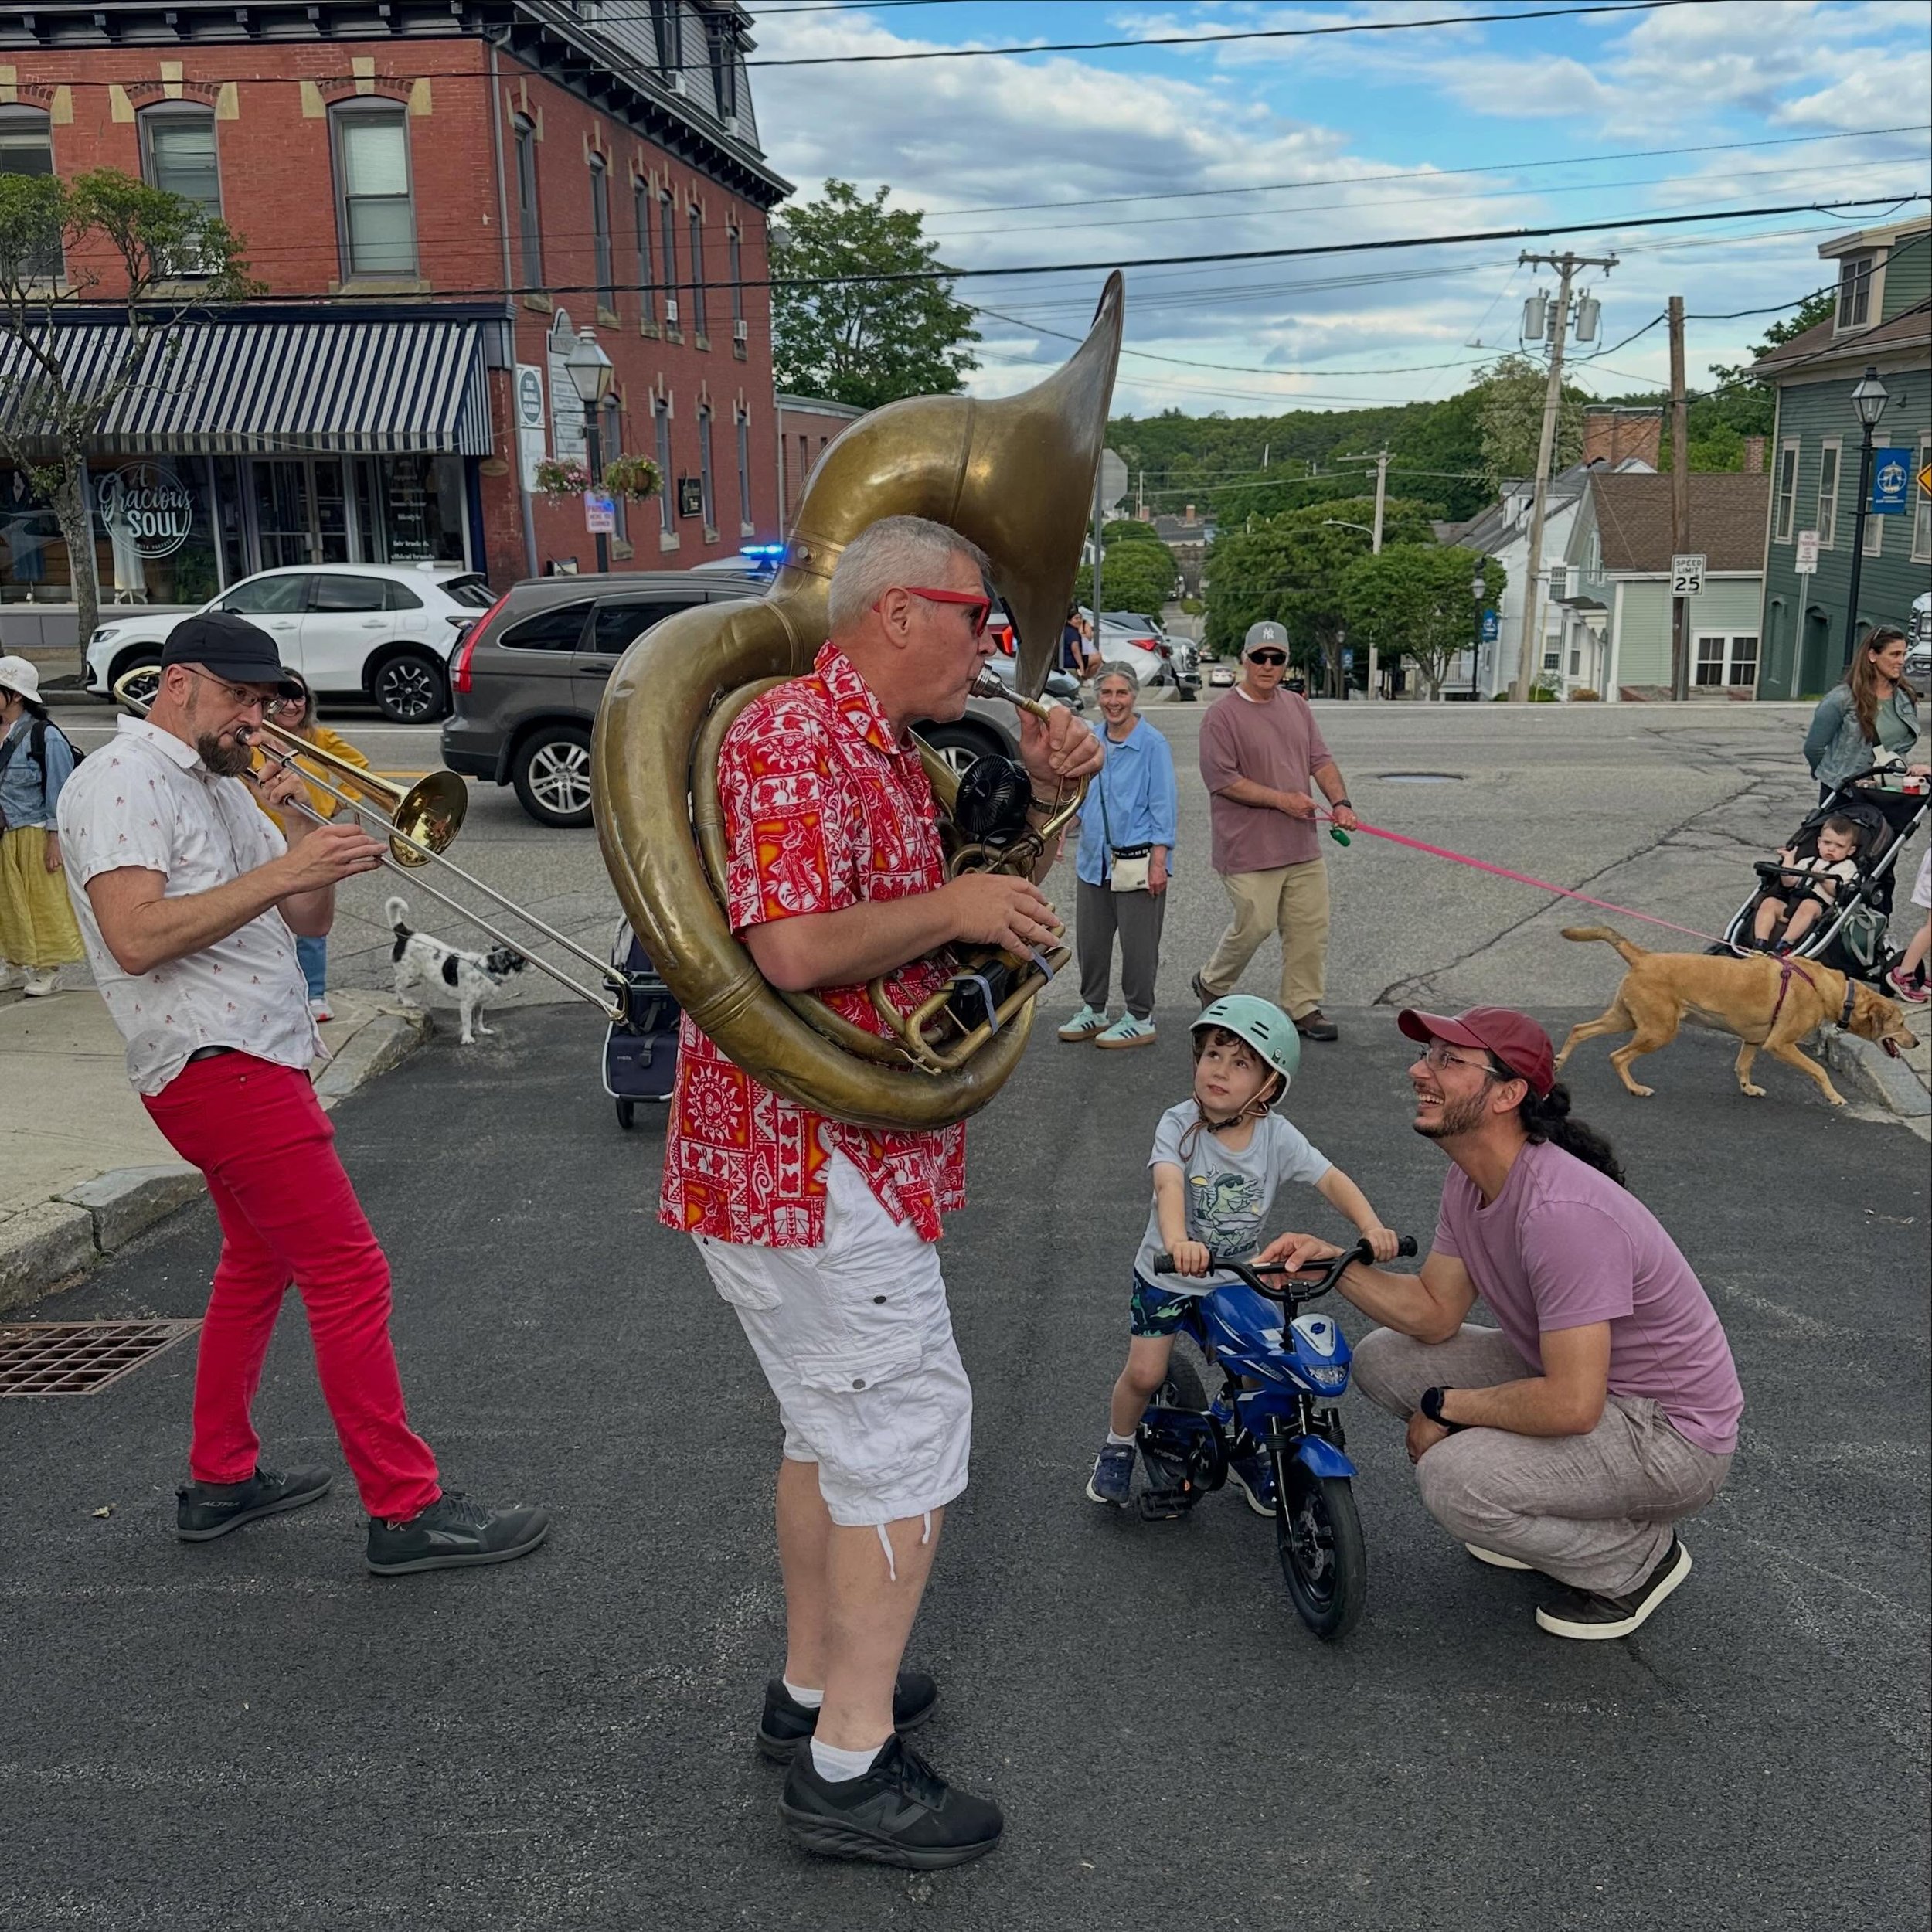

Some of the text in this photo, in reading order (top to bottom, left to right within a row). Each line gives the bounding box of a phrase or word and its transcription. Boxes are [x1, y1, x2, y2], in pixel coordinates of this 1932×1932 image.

[130, 464, 149, 487] A
[94, 471, 195, 522] Gracious
[127, 509, 185, 538] SOUL
[1675, 577, 1700, 592] 25
[1263, 627, 1274, 640] NY
